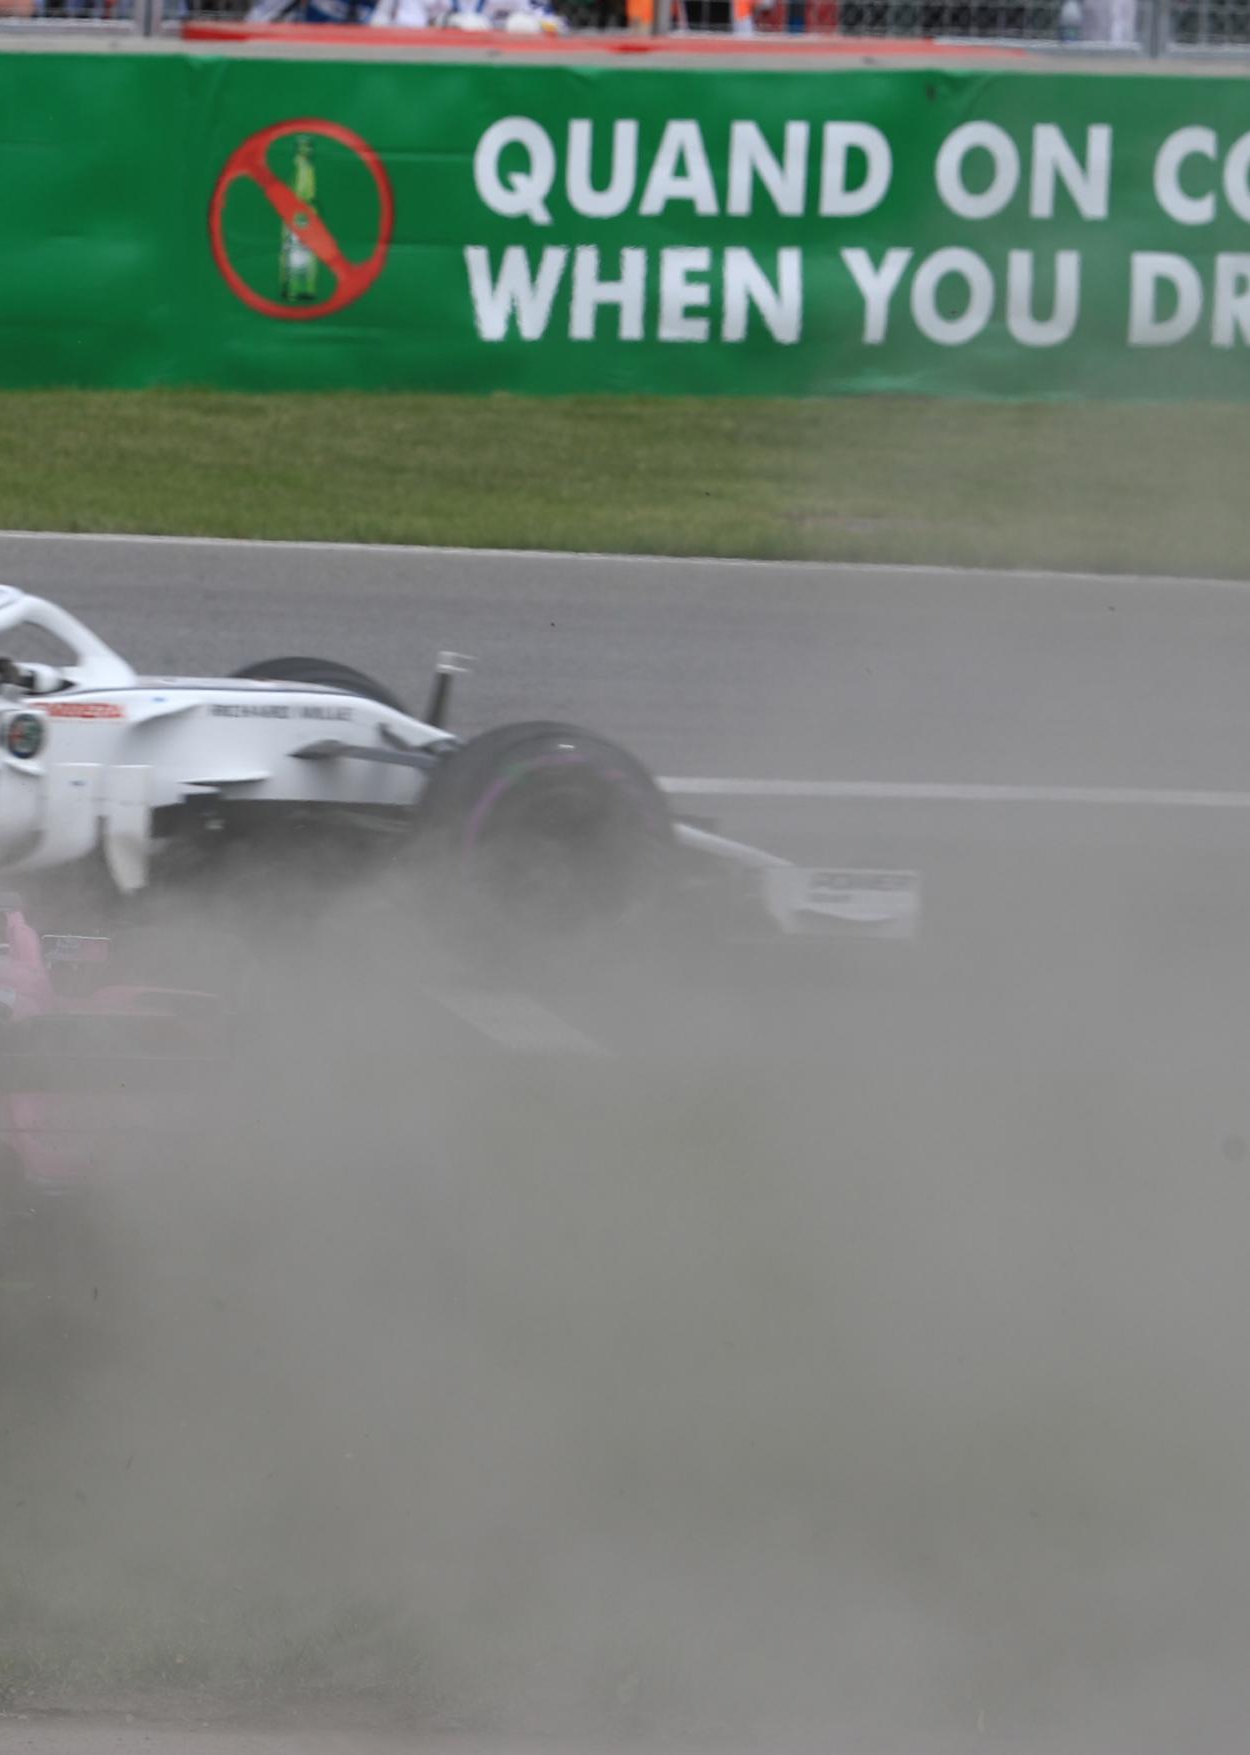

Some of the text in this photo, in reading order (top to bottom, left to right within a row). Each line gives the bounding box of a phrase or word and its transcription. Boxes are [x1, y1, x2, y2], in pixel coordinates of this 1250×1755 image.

[474, 117, 892, 225] QUAND
[935, 120, 1112, 220] ON
[464, 244, 803, 344] WHEN
[840, 246, 1082, 347] YOU
